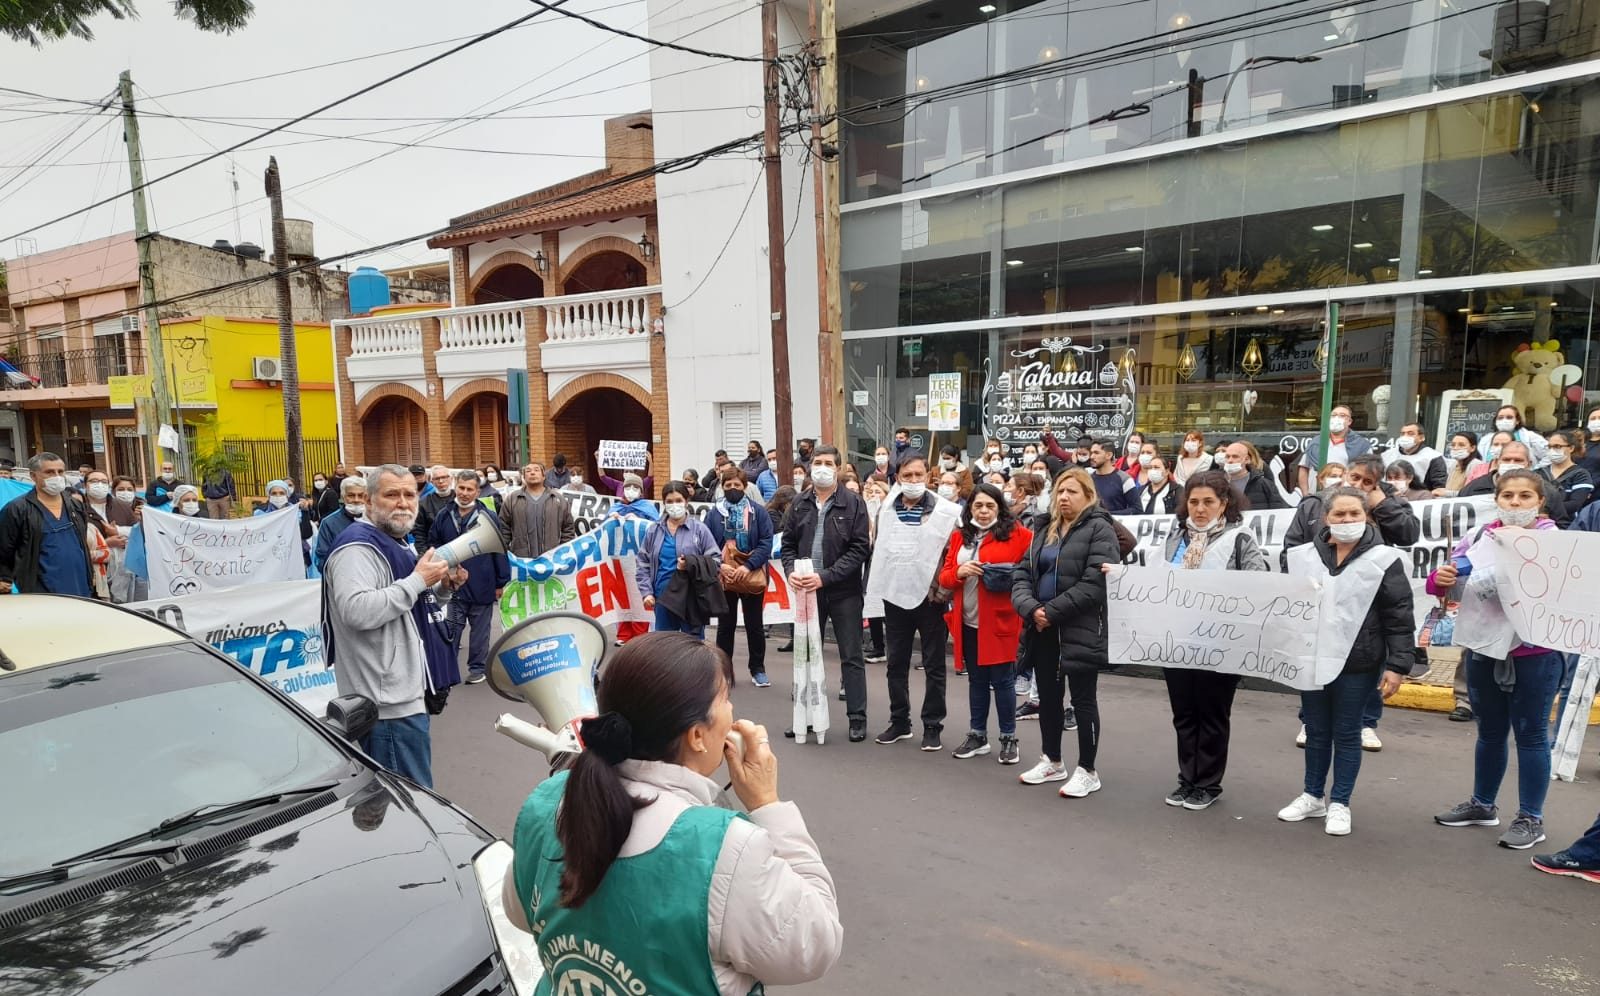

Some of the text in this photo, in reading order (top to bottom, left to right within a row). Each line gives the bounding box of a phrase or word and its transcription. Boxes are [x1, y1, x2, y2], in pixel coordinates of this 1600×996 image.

[931, 380, 959, 390] TERE
[1017, 361, 1095, 390] Tahona
[1048, 392, 1082, 408] PAN
[992, 414, 1021, 425] PIZZA
[1472, 423, 1487, 431] UN
[603, 450, 616, 458] CON
[1513, 535, 1582, 602] 8%
[576, 558, 631, 618] EN
[1259, 596, 1315, 631] por
[1189, 620, 1244, 640] un
[547, 934, 580, 957] UNA
